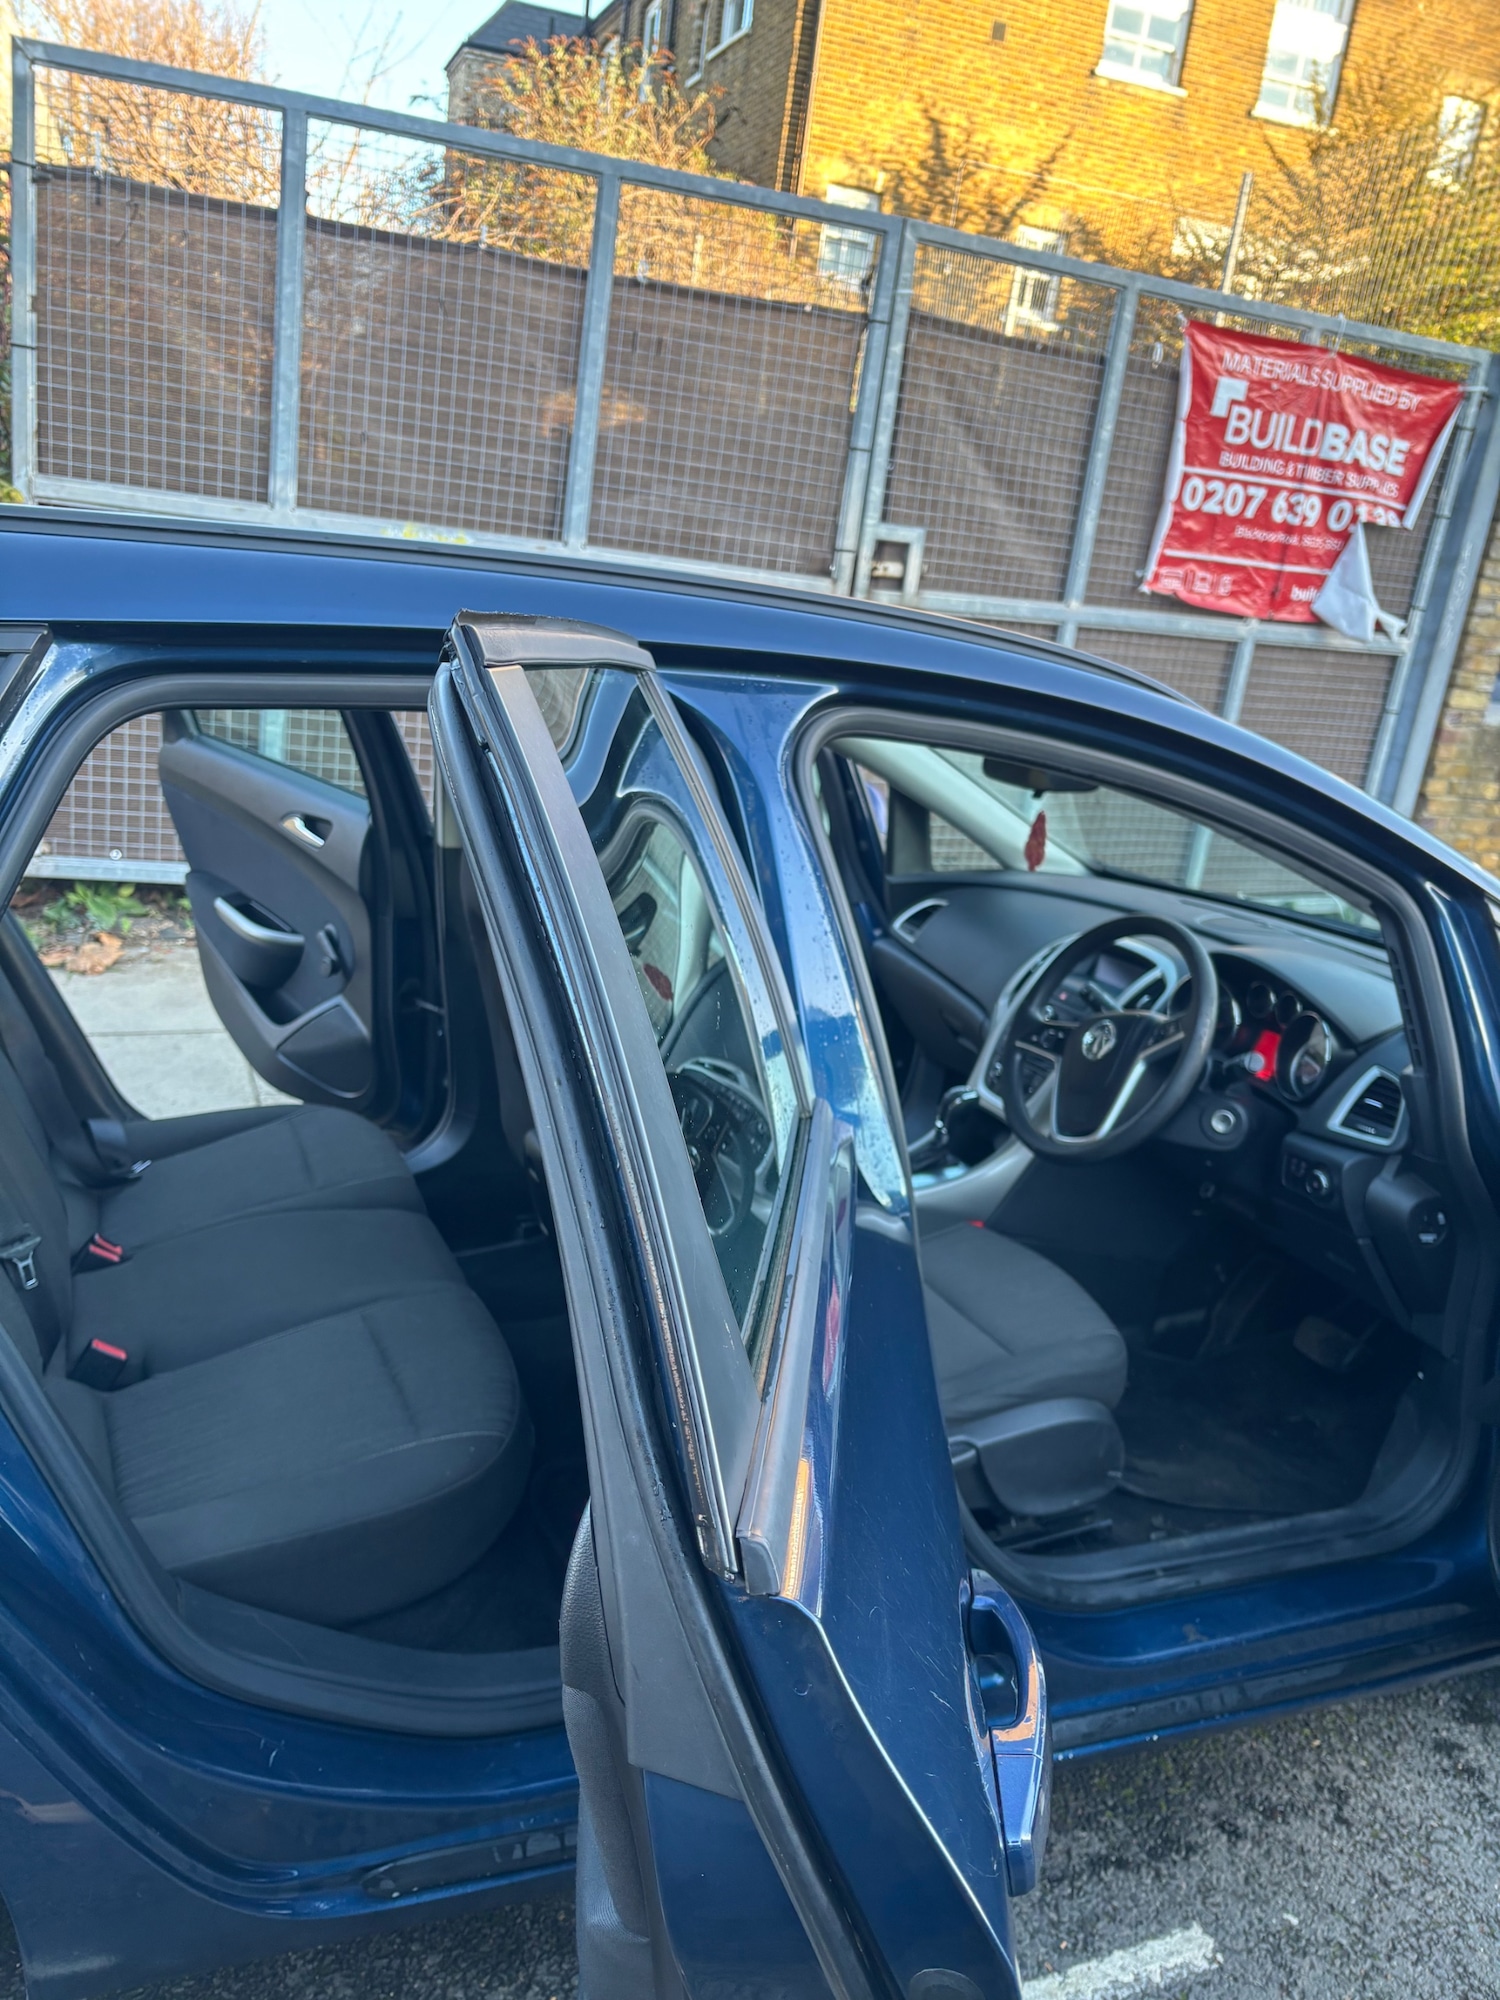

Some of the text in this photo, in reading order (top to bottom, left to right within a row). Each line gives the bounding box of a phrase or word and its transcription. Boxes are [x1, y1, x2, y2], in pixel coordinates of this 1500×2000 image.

[1222, 351, 1423, 412] MATERIALS SUPPLIED BY
[1219, 451, 1286, 475] BUILDING
[1224, 405, 1410, 477] BUILDBASE
[1182, 476, 1267, 518] 0207
[1271, 490, 1322, 528] 639
